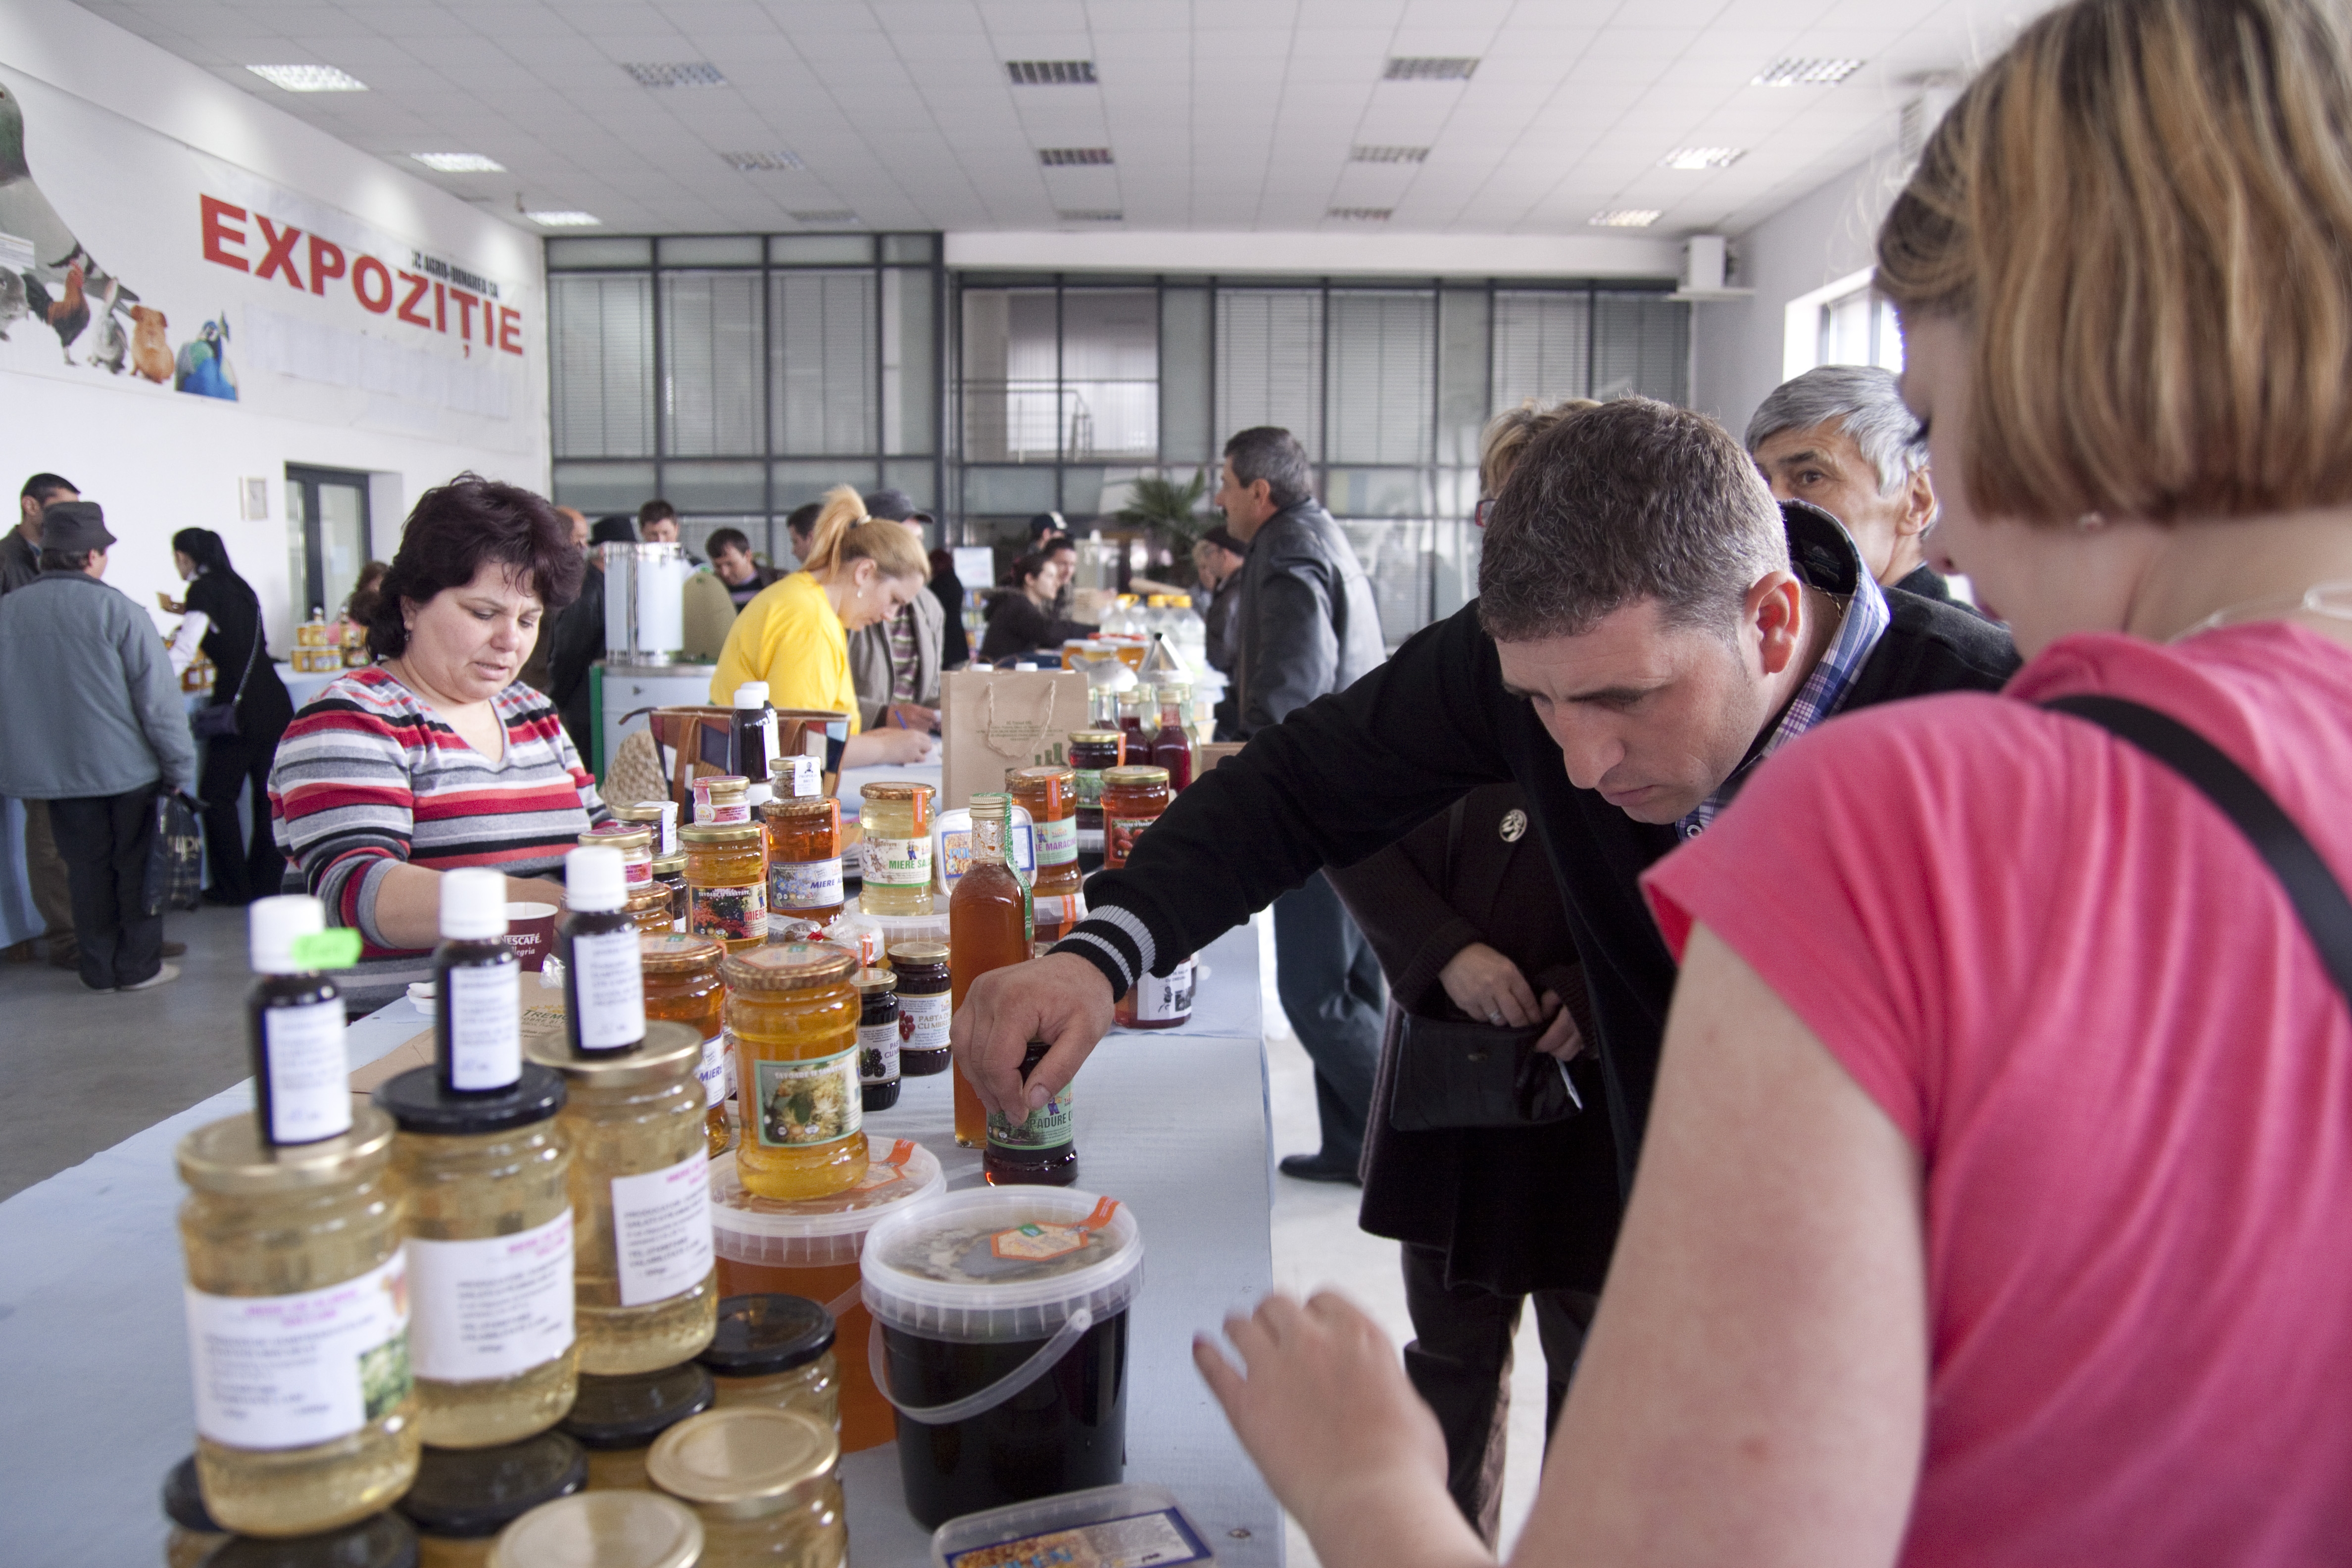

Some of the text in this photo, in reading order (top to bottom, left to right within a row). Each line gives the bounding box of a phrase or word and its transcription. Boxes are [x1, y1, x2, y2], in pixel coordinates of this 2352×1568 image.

[949, 847, 972, 860] POL
[888, 860, 915, 870] MIERE
[810, 879, 835, 889] MIERE
[744, 908, 765, 922] MIERE
[523, 1009, 568, 1020] TREMO
[884, 1050, 893, 1059] CU
